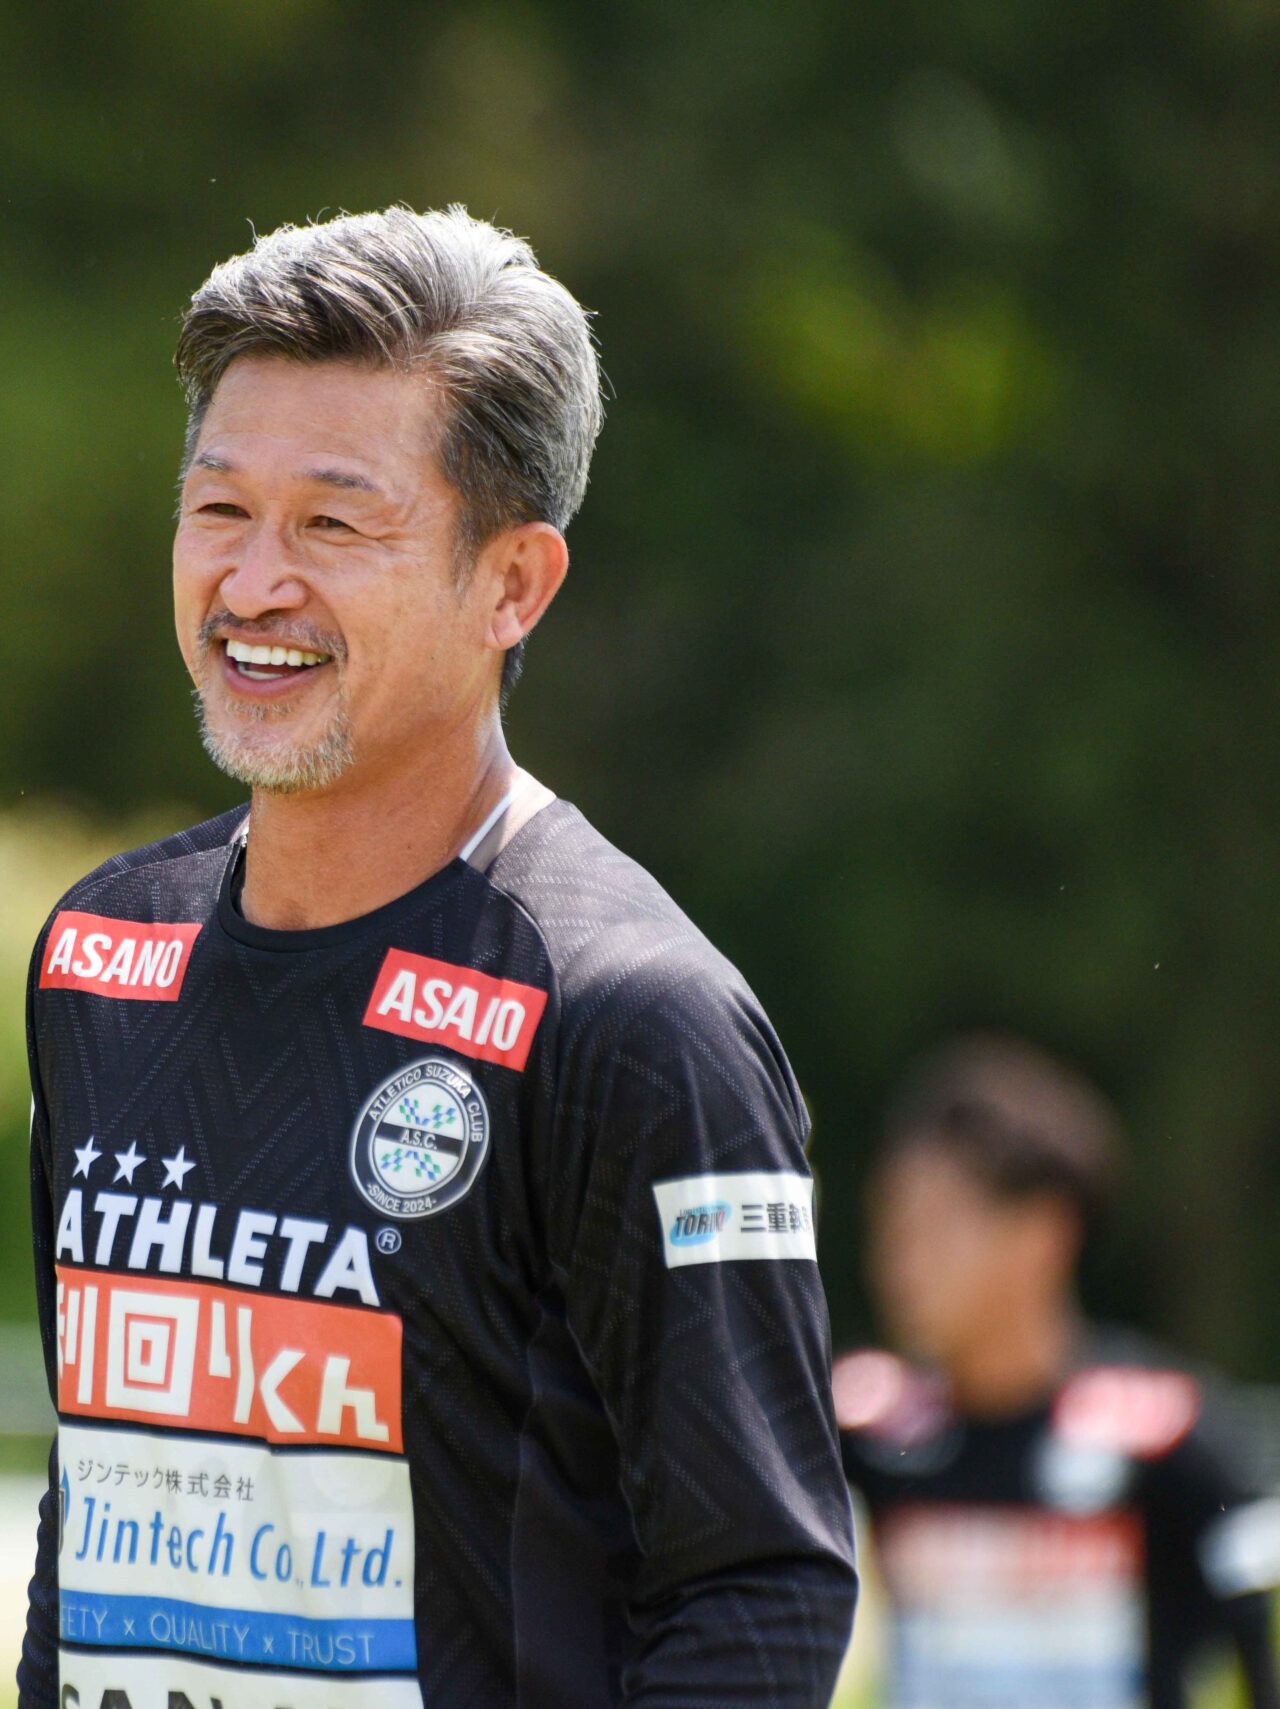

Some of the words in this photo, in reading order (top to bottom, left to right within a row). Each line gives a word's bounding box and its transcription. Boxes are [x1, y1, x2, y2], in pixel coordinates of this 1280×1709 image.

[47, 928, 183, 988] ASANO
[369, 1069, 422, 1122] ATLETICO
[425, 1064, 472, 1099] SUZUKA
[468, 1101, 483, 1143] CLUB
[400, 1129, 438, 1150] A.S.C.
[56, 1189, 380, 1307] ATHLETA
[77, 1459, 254, 1501] ジンテック株式会社
[75, 1496, 235, 1577] Jintech
[149, 1612, 251, 1656] QUALITY
[287, 1627, 375, 1665] TRUST
